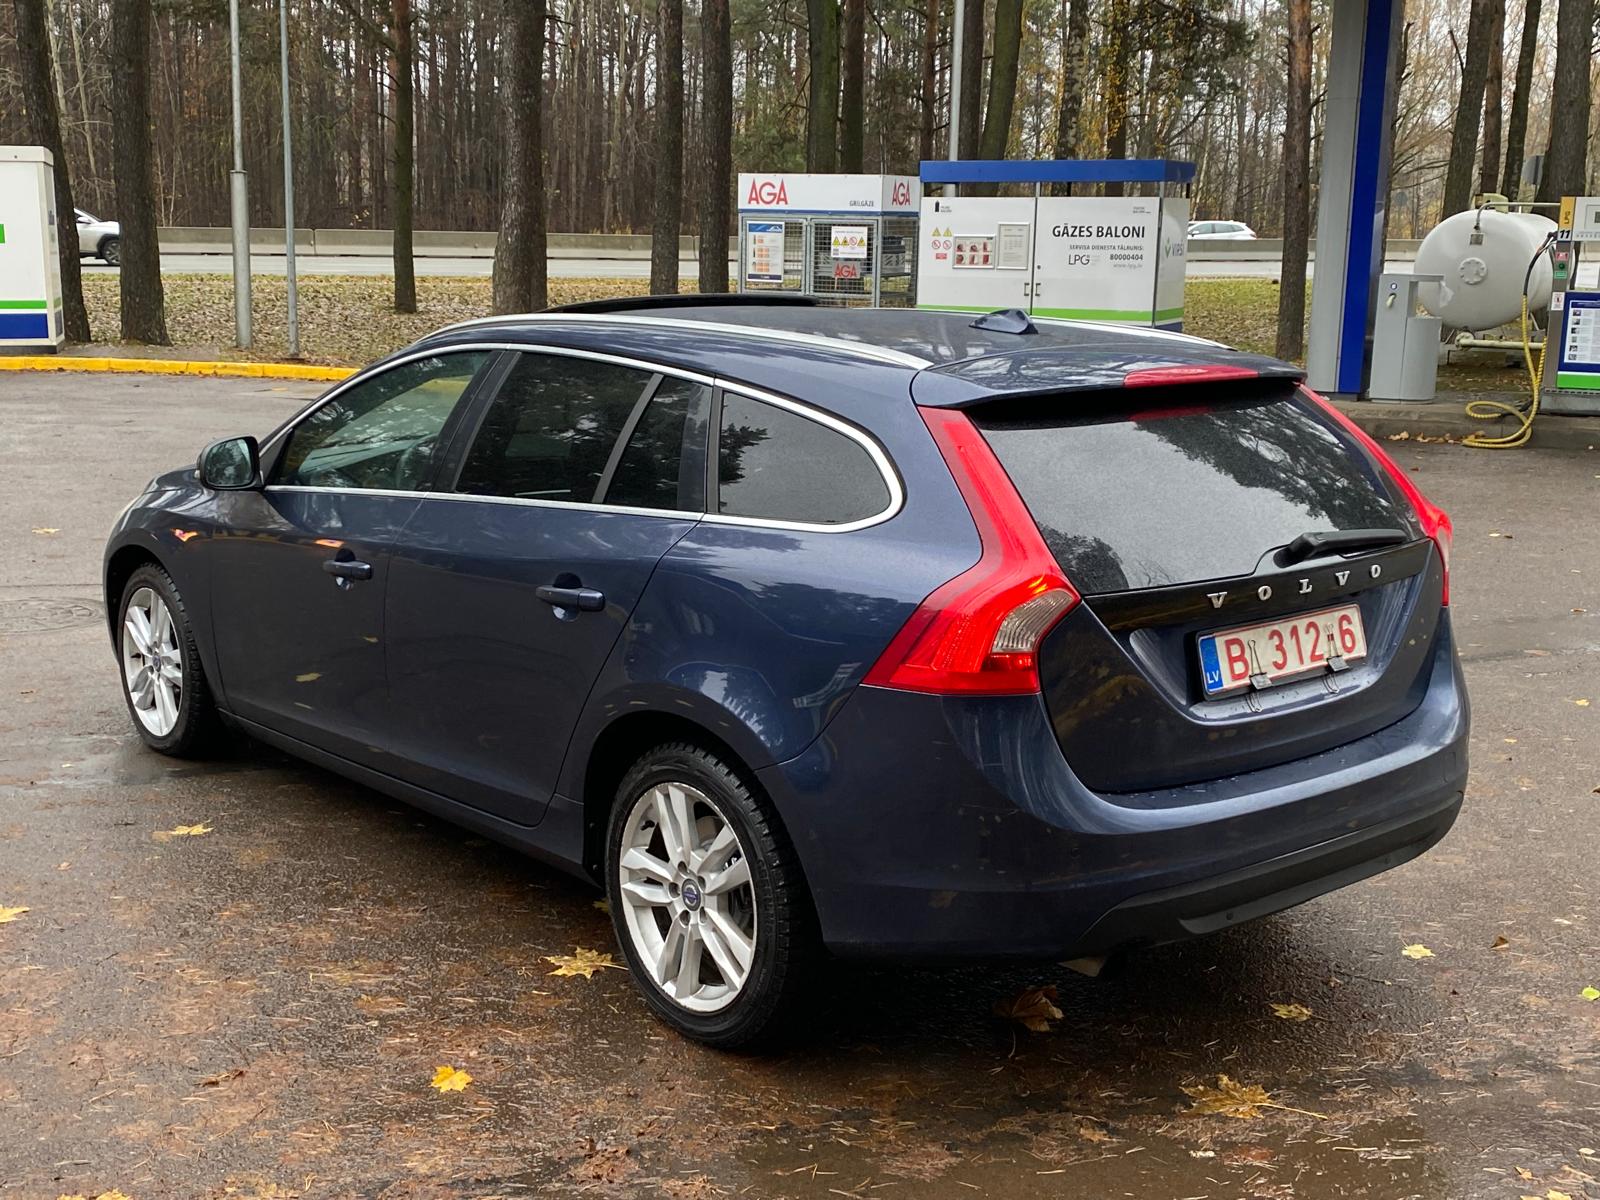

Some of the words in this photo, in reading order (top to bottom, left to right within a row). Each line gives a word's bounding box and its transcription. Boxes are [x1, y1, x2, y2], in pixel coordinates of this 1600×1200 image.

[748, 177, 789, 206] AGA
[891, 180, 911, 205] AGA
[1052, 222, 1093, 238] GĀZES
[1096, 225, 1145, 239] BALONI
[1559, 229, 1571, 239] 11
[1068, 254, 1090, 266] LPG
[1109, 253, 1144, 261] 80000404
[834, 264, 857, 278] AGA
[1206, 564, 1382, 609] VOLVO
[1206, 670, 1220, 684] LV
